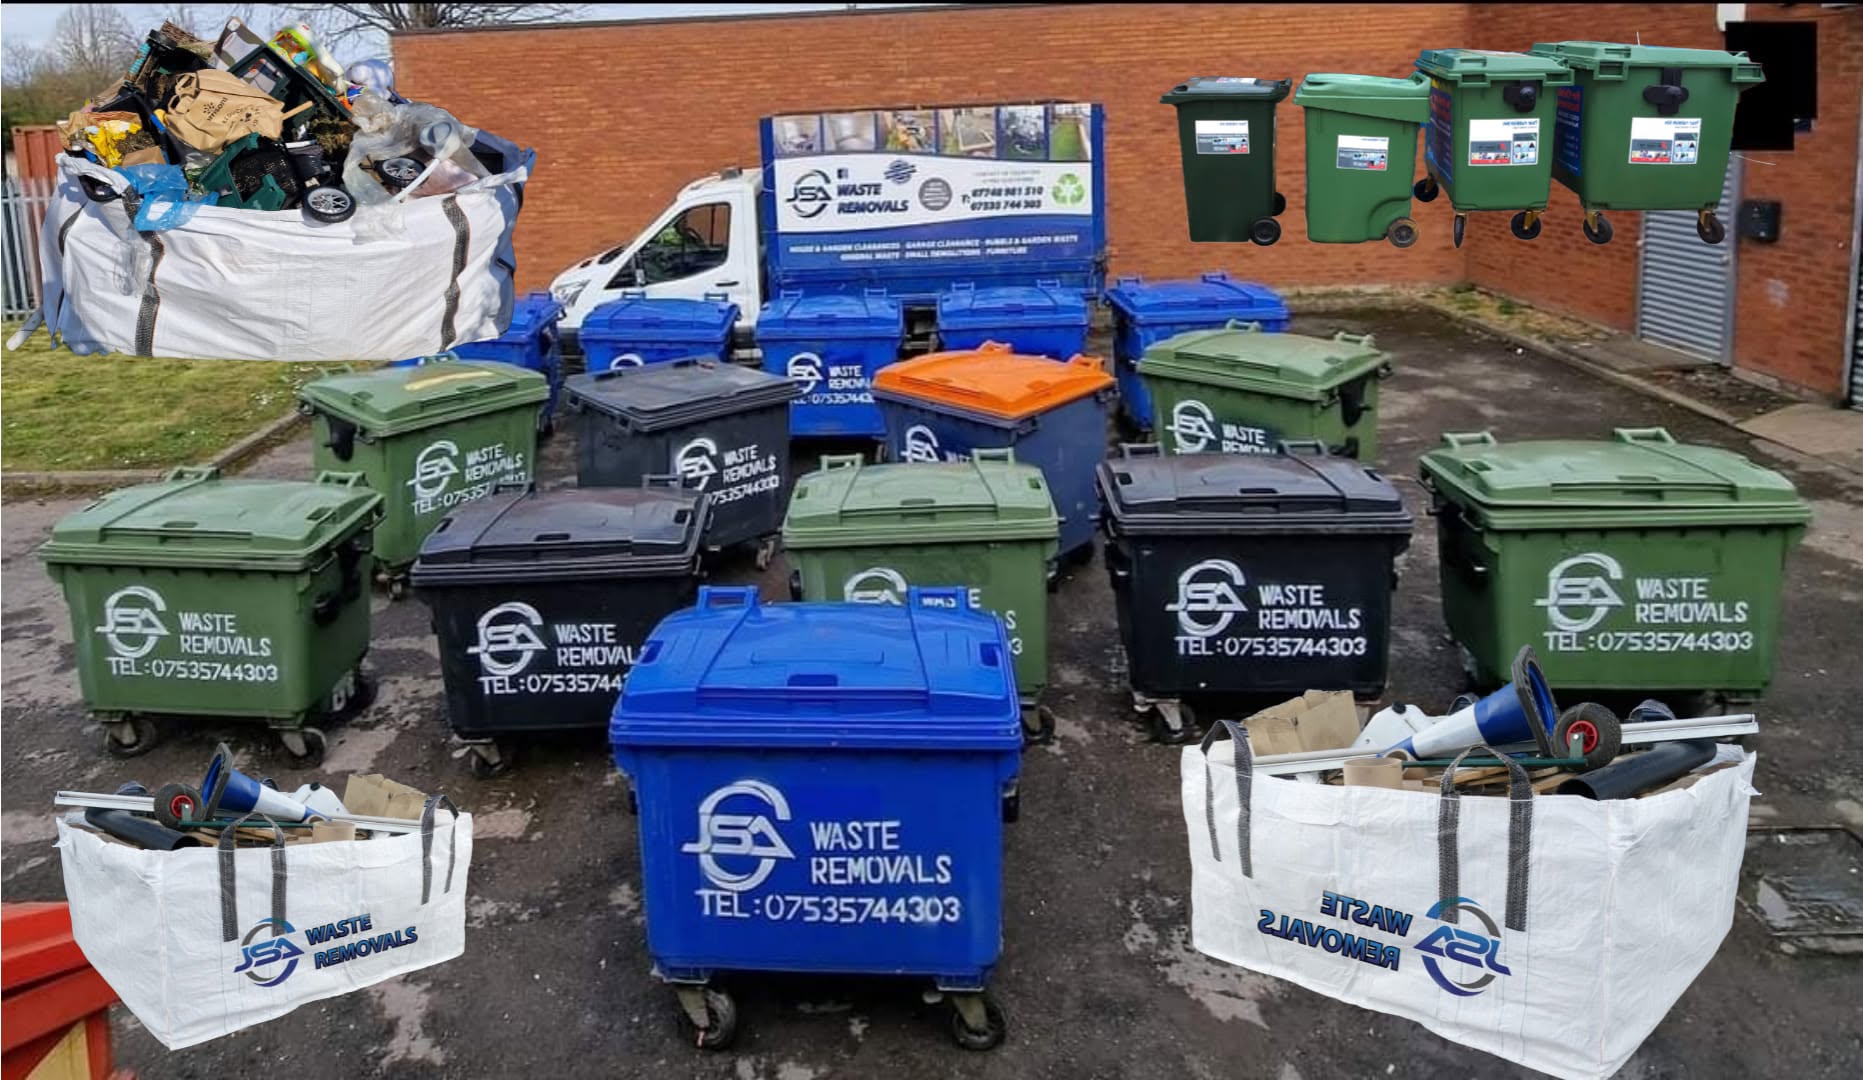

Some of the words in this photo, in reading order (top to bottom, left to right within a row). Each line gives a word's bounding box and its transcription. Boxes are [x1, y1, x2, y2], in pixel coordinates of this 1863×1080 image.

[837, 183, 882, 196] WASTE
[837, 200, 909, 214] REMOVALS
[829, 365, 863, 377] WASTE
[1221, 424, 1266, 446] WASTE
[466, 442, 504, 466] WASTE
[723, 444, 758, 466] WASTE
[465, 452, 524, 483] REMOVALS
[723, 454, 777, 483] REMOVALS
[1258, 585, 1325, 606] WASTE
[1635, 577, 1710, 600] WASTE
[178, 612, 237, 633] WASTE
[1258, 608, 1362, 630] REMOVALS
[1635, 600, 1749, 624] REMOVALS
[554, 624, 617, 644] WASTE
[179, 634, 272, 657] REMOVALS
[556, 645, 646, 667] REMOVAL
[809, 820, 901, 851] WASTE
[810, 855, 953, 885] REMOVALS
[304, 912, 373, 946] WASTE
[314, 926, 419, 970] REMOVALS
